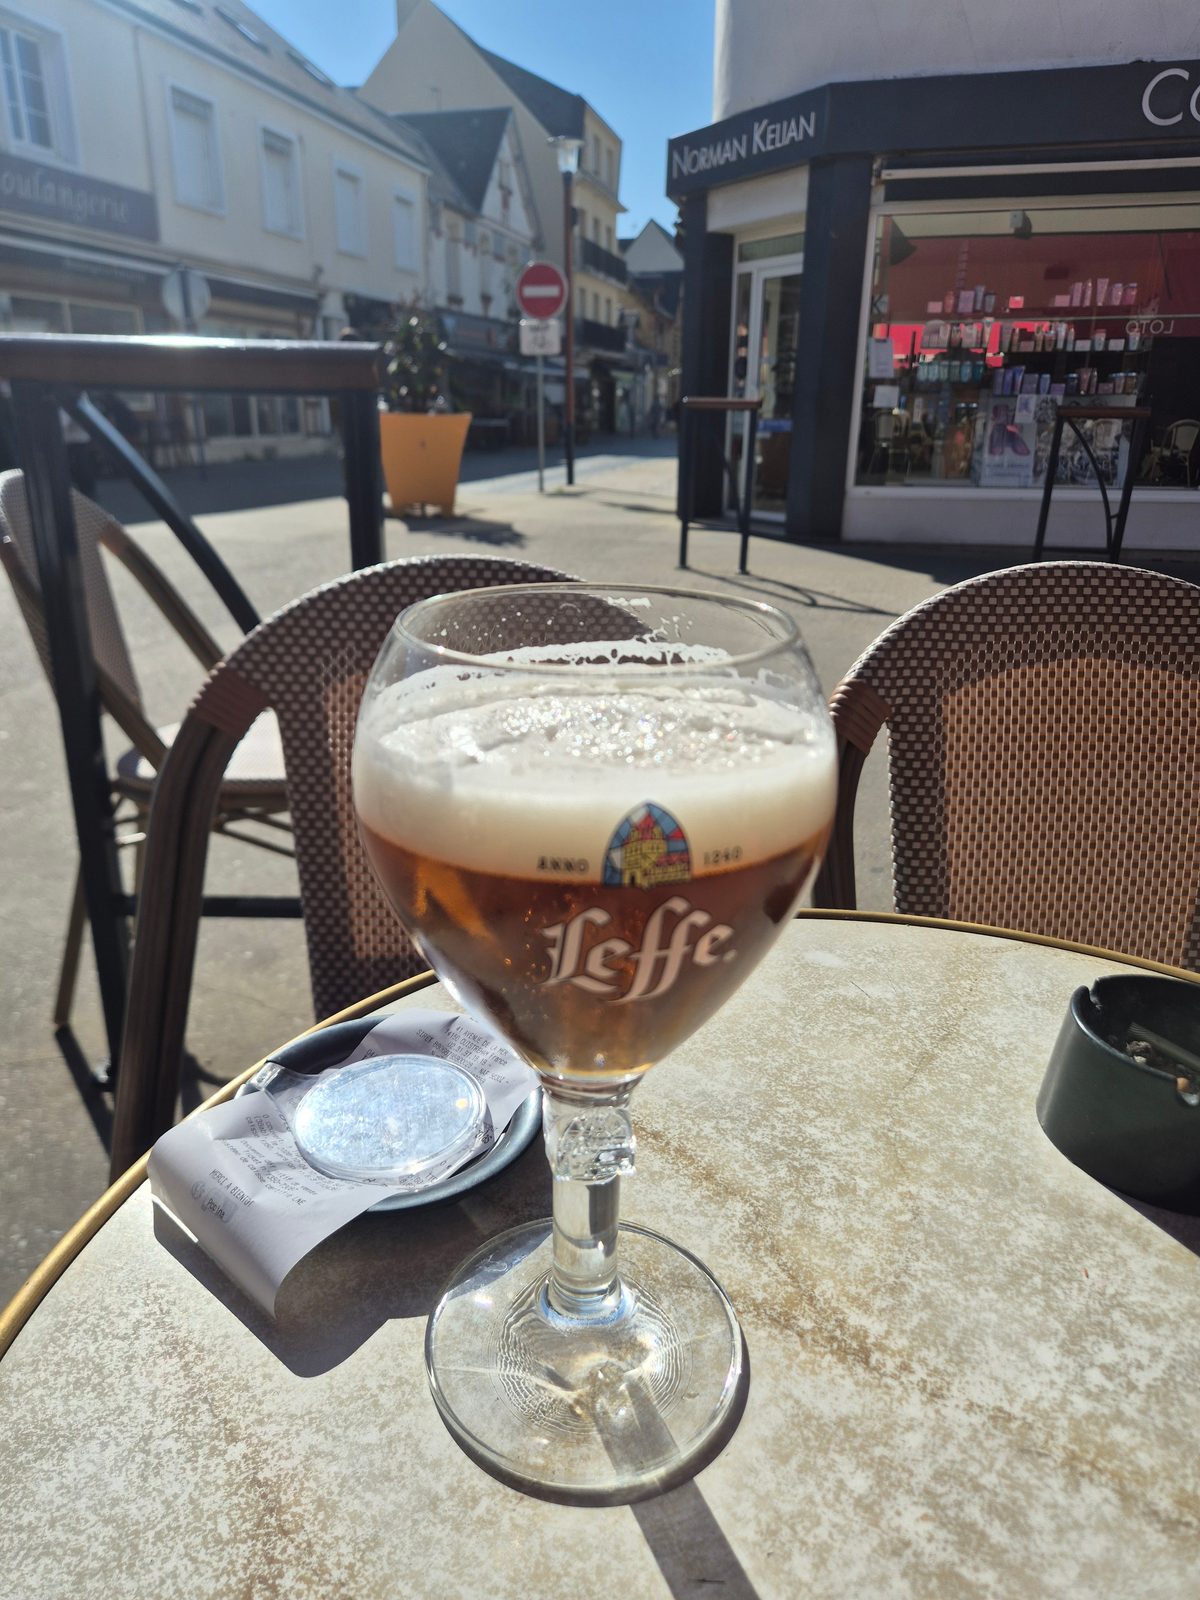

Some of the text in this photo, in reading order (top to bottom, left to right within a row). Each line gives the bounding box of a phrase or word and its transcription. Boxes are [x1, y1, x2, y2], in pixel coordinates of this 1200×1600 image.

[1142, 68, 1200, 126] C
[672, 112, 816, 179] NORMAN KELIAN
[536, 846, 743, 874] ANNO 1240
[462, 1030, 482, 1043] AVENUE
[209, 1168, 228, 1186] MERCI
[224, 1181, 233, 1190] A
